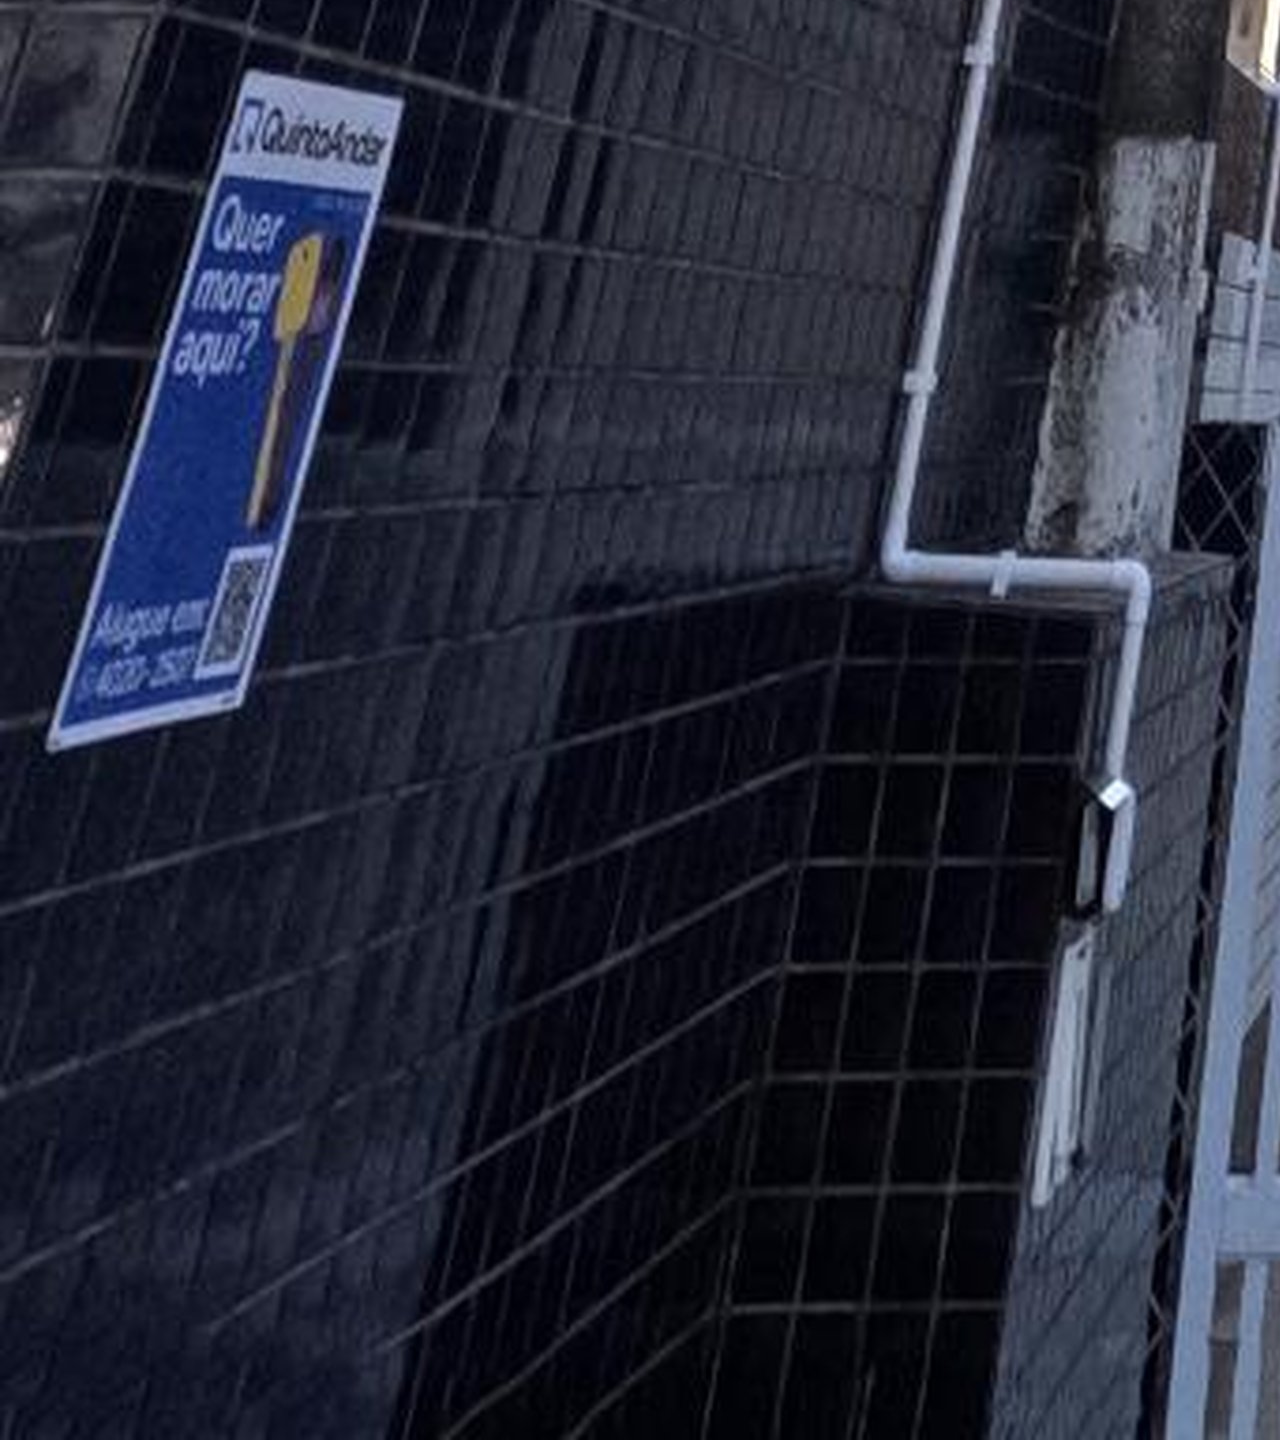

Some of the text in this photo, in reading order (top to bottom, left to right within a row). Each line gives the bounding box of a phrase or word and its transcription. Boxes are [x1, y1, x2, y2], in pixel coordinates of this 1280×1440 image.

[212, 194, 285, 254] Quer
[192, 268, 281, 315] morar
[173, 316, 262, 390] aqui?
